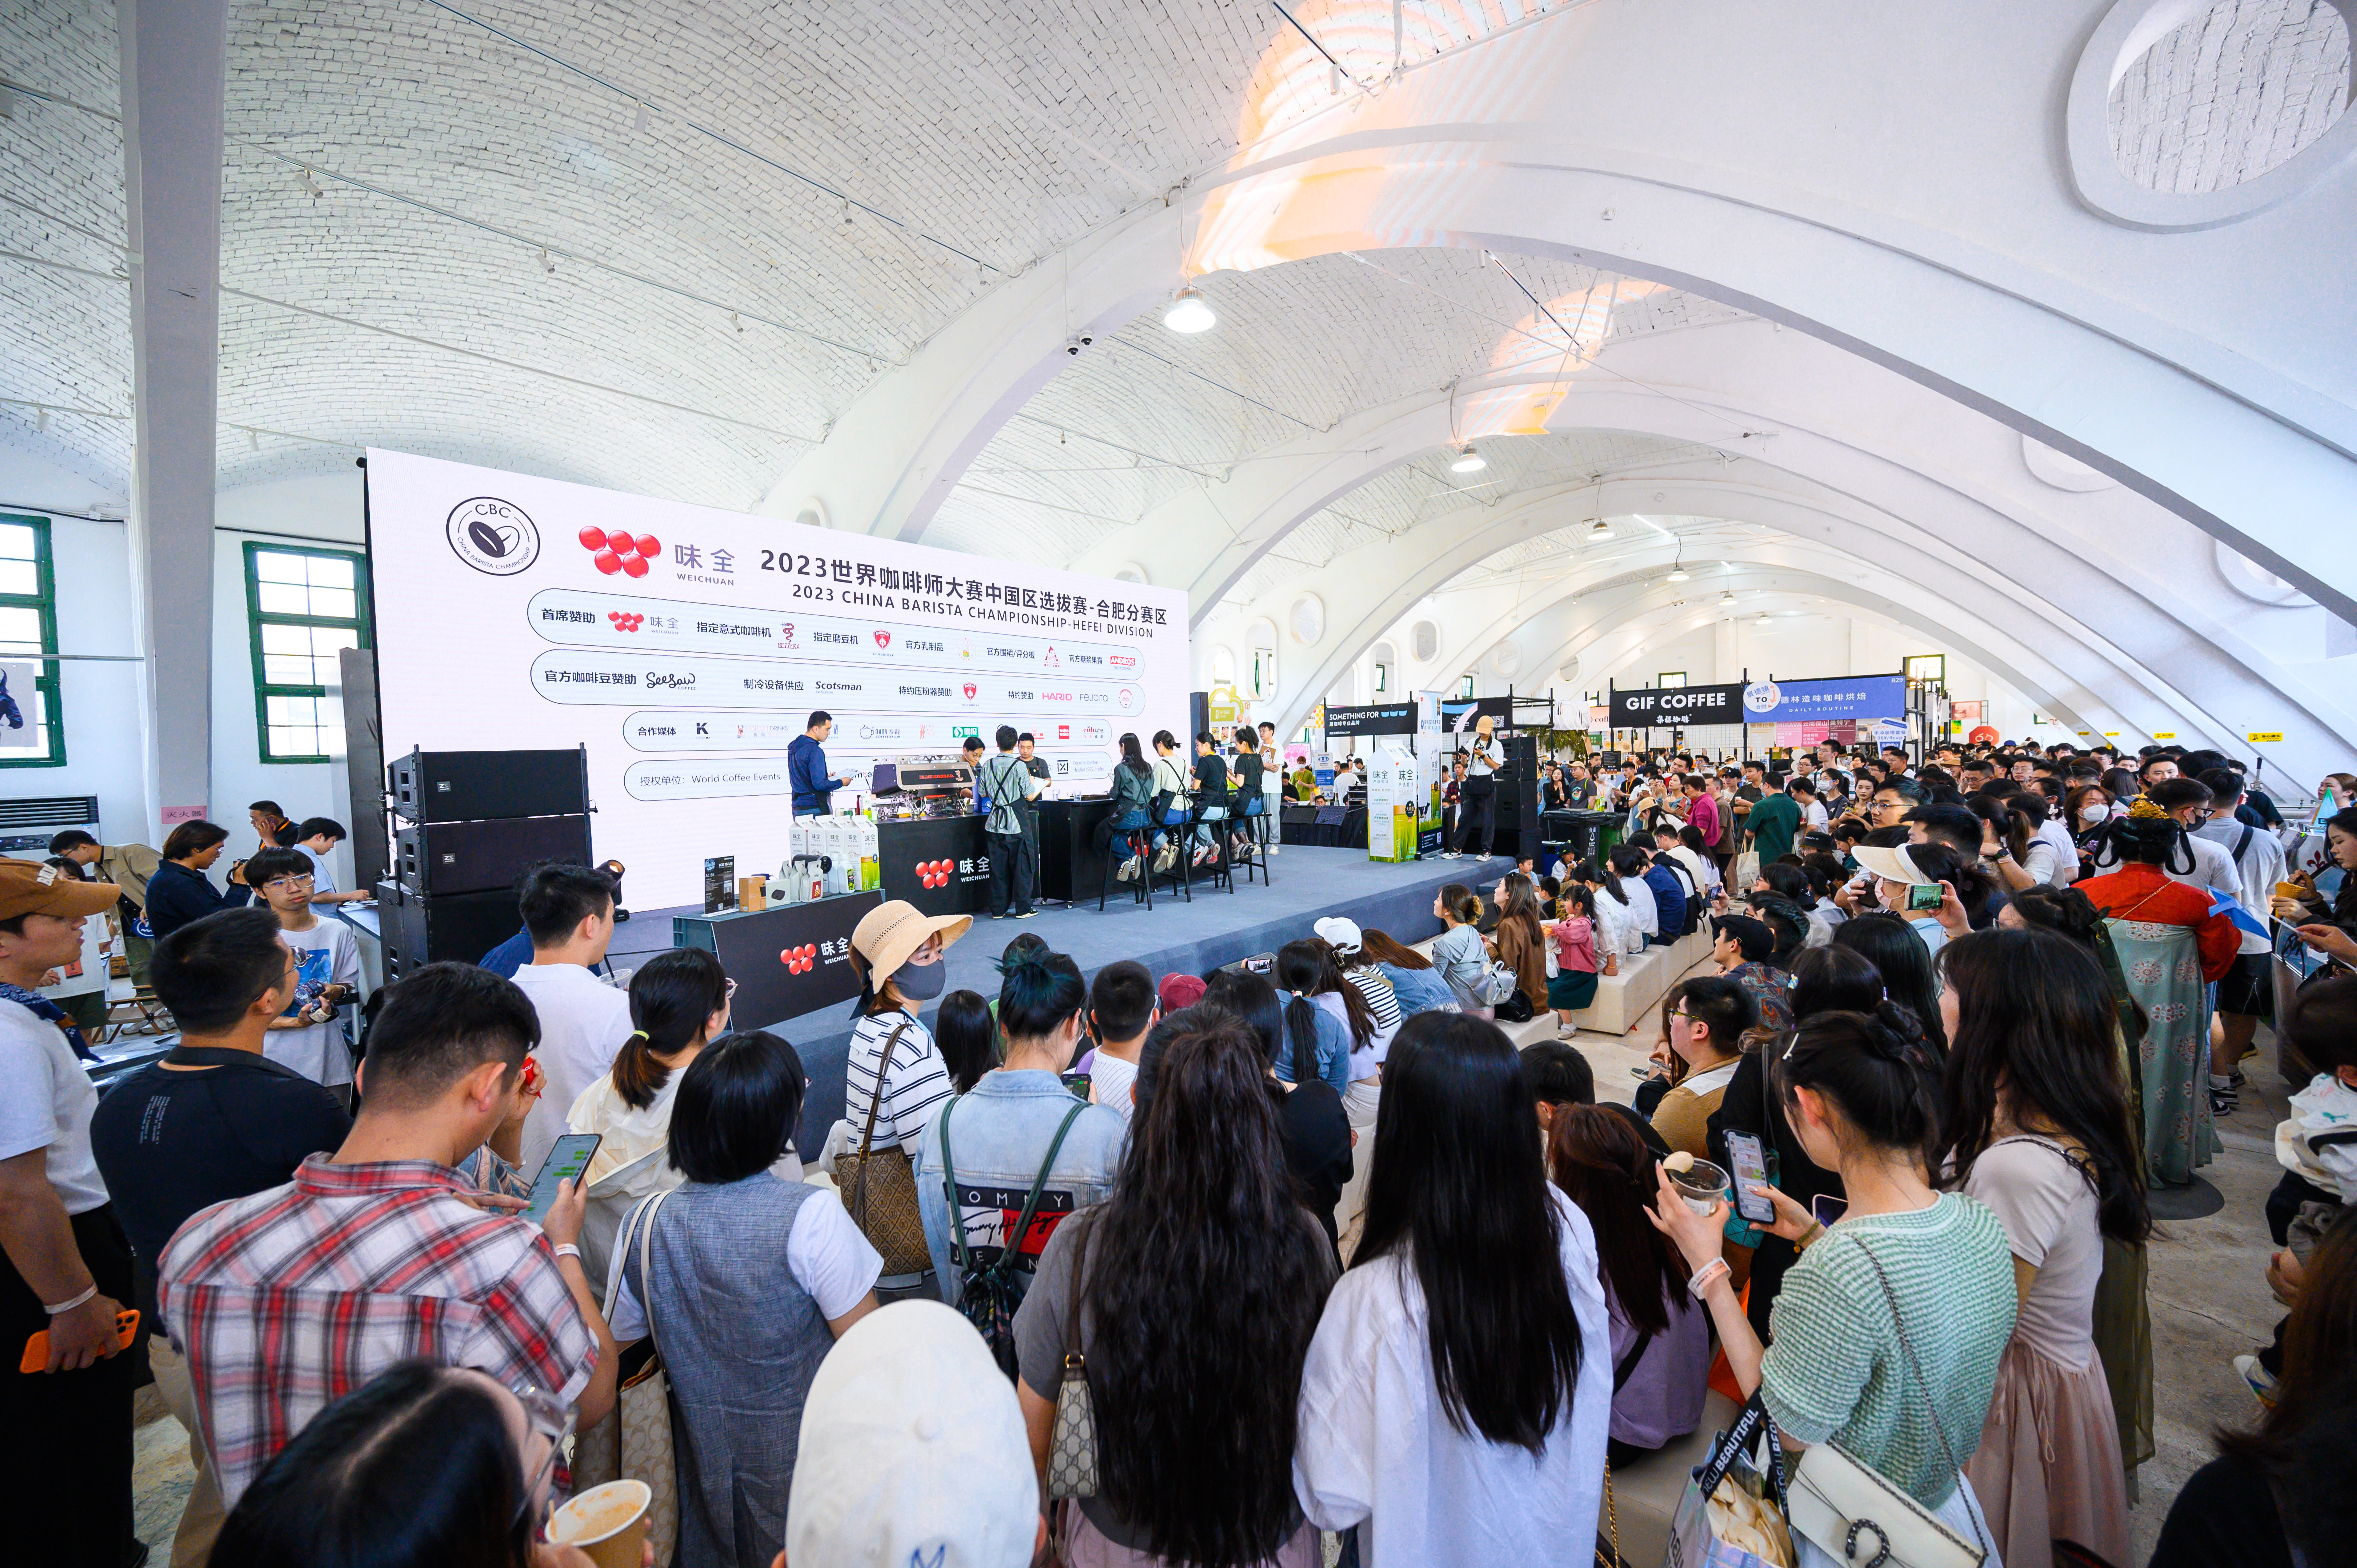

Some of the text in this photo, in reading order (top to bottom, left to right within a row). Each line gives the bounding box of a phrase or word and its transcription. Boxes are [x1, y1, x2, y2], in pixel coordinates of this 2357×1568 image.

[475, 504, 511, 517] CBC
[458, 537, 530, 569] CHINA BARISTA CHAMPIONSHIP
[675, 544, 735, 574] 味全
[677, 573, 734, 586] WEICHUAN
[761, 549, 1167, 625] 2023世界咖啡师大赛中国区选拔赛-合肥分赛区
[541, 608, 595, 624] 首席赞助
[793, 584, 1152, 638] 2023 CHINA BARISTA CHAMPIONSHIP-HEFEI DIVISION
[650, 616, 678, 629] 味全
[697, 622, 772, 638] 指定意式咖啡机
[813, 631, 859, 645] 指定磨豆机
[905, 640, 944, 652] 官方乳制品
[987, 647, 1035, 659] 官方围裙/评分板
[1111, 657, 1135, 665] ANDROS
[544, 671, 636, 685] 官方咖啡豆赞助
[744, 679, 804, 691] 制冷设备供应
[816, 681, 862, 691] Scotsman
[898, 686, 952, 697] 特约压粉器赞助
[1008, 690, 1033, 700] 特约赞助
[1042, 692, 1072, 701] HARIO
[1746, 685, 1770, 698] 景德镇
[1626, 692, 1725, 710] GIF COFFEE
[1781, 692, 1867, 704] 德林造味咖啡烘焙
[1329, 712, 1366, 720] SOMETHING
[638, 727, 676, 736] 合作媒体
[692, 775, 719, 783] World
[723, 773, 751, 782] Coffee
[1373, 770, 1388, 779] 味全
[1398, 769, 1413, 780] 味全
[165, 810, 203, 819] 灭火器
[959, 856, 989, 874] 味全
[961, 874, 989, 882] WEICHUAN
[821, 937, 849, 956] 味全
[1715, 1409, 1759, 1472] BEAUTIFUL
